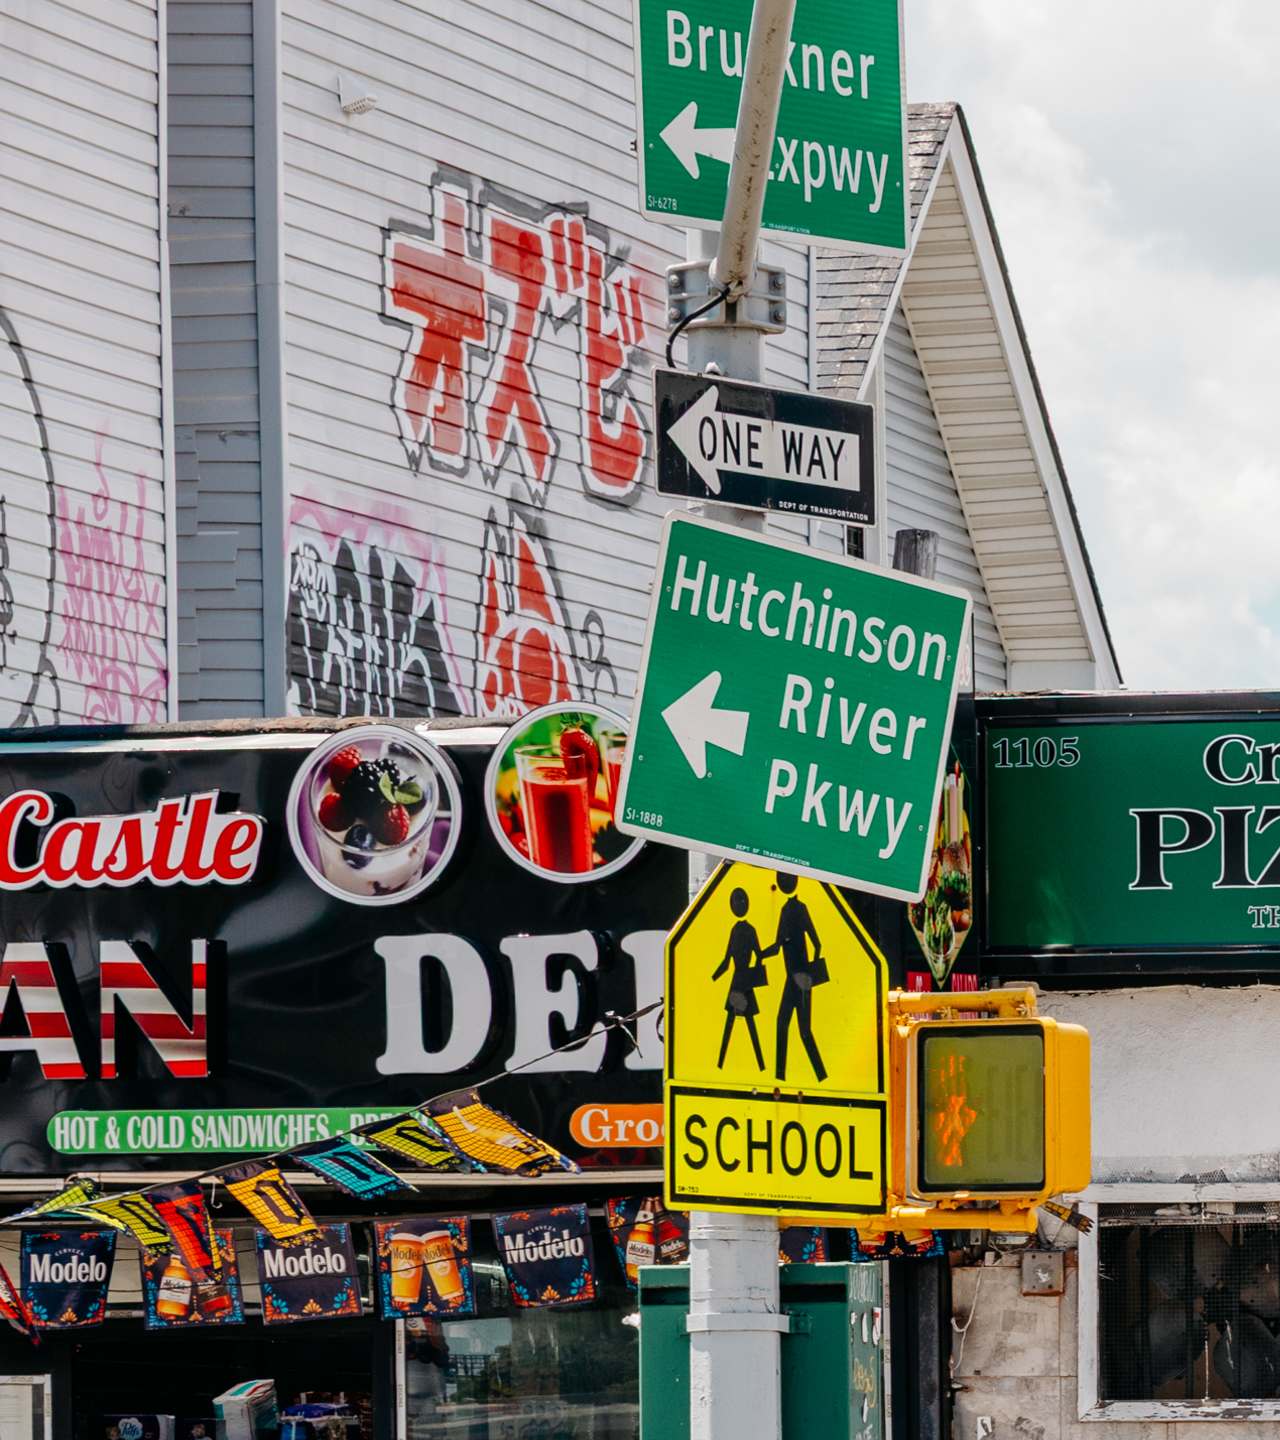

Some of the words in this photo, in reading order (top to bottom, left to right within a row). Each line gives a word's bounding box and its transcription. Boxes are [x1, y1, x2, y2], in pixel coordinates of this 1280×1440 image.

[768, 136, 888, 213] xpwy
[699, 415, 763, 469] ONE
[782, 429, 846, 481] WAY
[779, 501, 796, 511] DEPT
[798, 503, 808, 512] OF
[810, 505, 869, 521] TRANSPORTATION
[671, 554, 949, 681] Hutchinson
[779, 673, 927, 761] River
[993, 736, 1081, 768] 1105
[764, 758, 913, 860] Pkwy
[0, 788, 263, 891] Castle
[54, 1115, 100, 1150] HOT
[104, 1116, 122, 1149] &
[126, 1114, 186, 1150] COLD
[190, 1112, 330, 1150] SANDWICHES
[581, 1108, 664, 1143] Gro
[683, 1114, 874, 1181] SCHOOL
[30, 1253, 107, 1283] Modelo
[263, 1247, 346, 1278] Modelo
[503, 1229, 584, 1265] Modelo
